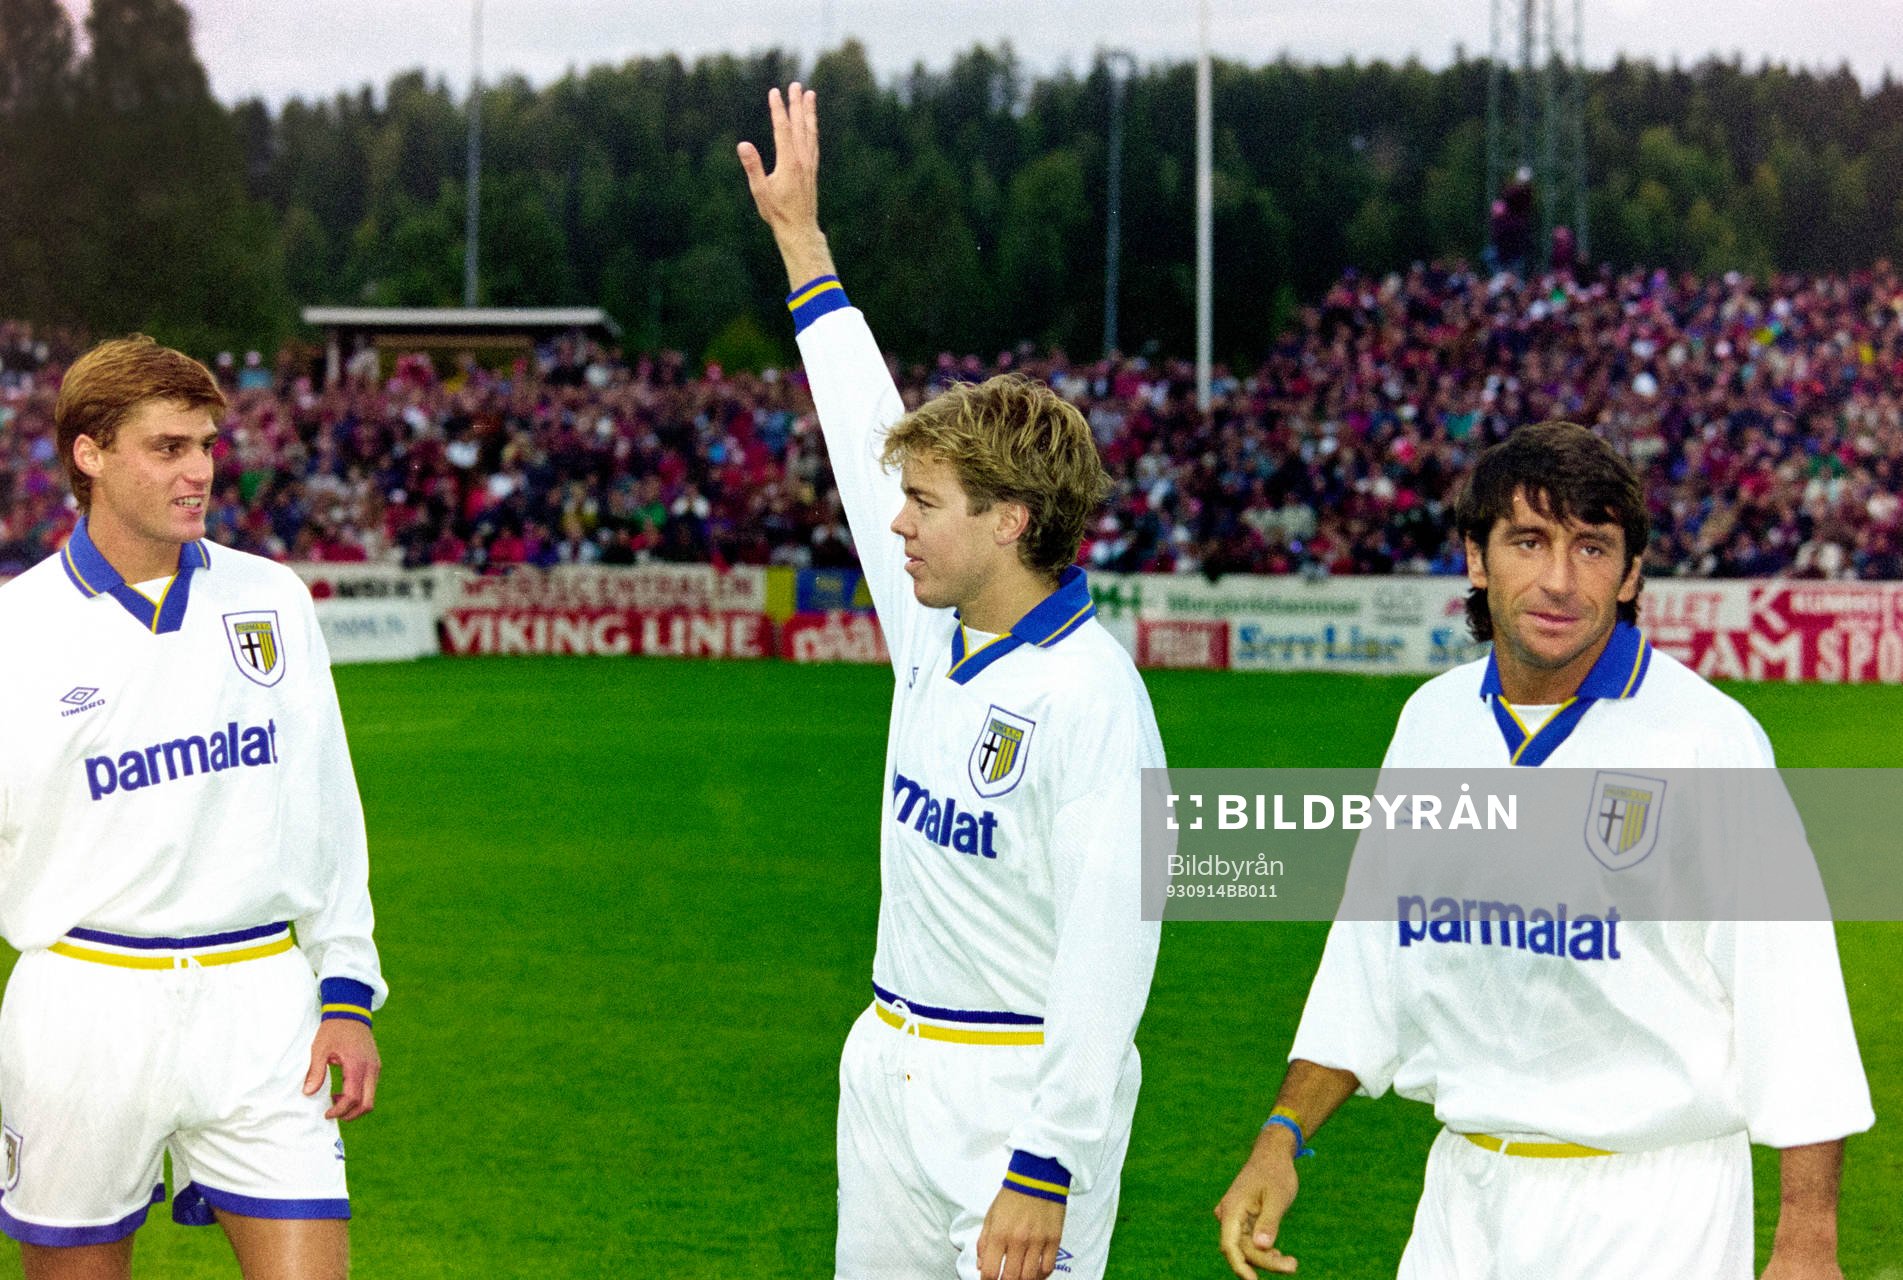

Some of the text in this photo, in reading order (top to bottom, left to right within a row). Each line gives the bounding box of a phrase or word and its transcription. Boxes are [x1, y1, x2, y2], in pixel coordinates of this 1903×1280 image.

[445, 612, 633, 656] VIKING
[641, 613, 765, 659] LINE
[1648, 627, 1802, 679] EAM
[61, 699, 105, 717] UMBRO
[85, 718, 278, 801] parmalat
[893, 773, 998, 859] malat
[1397, 895, 1621, 961] parmalat
